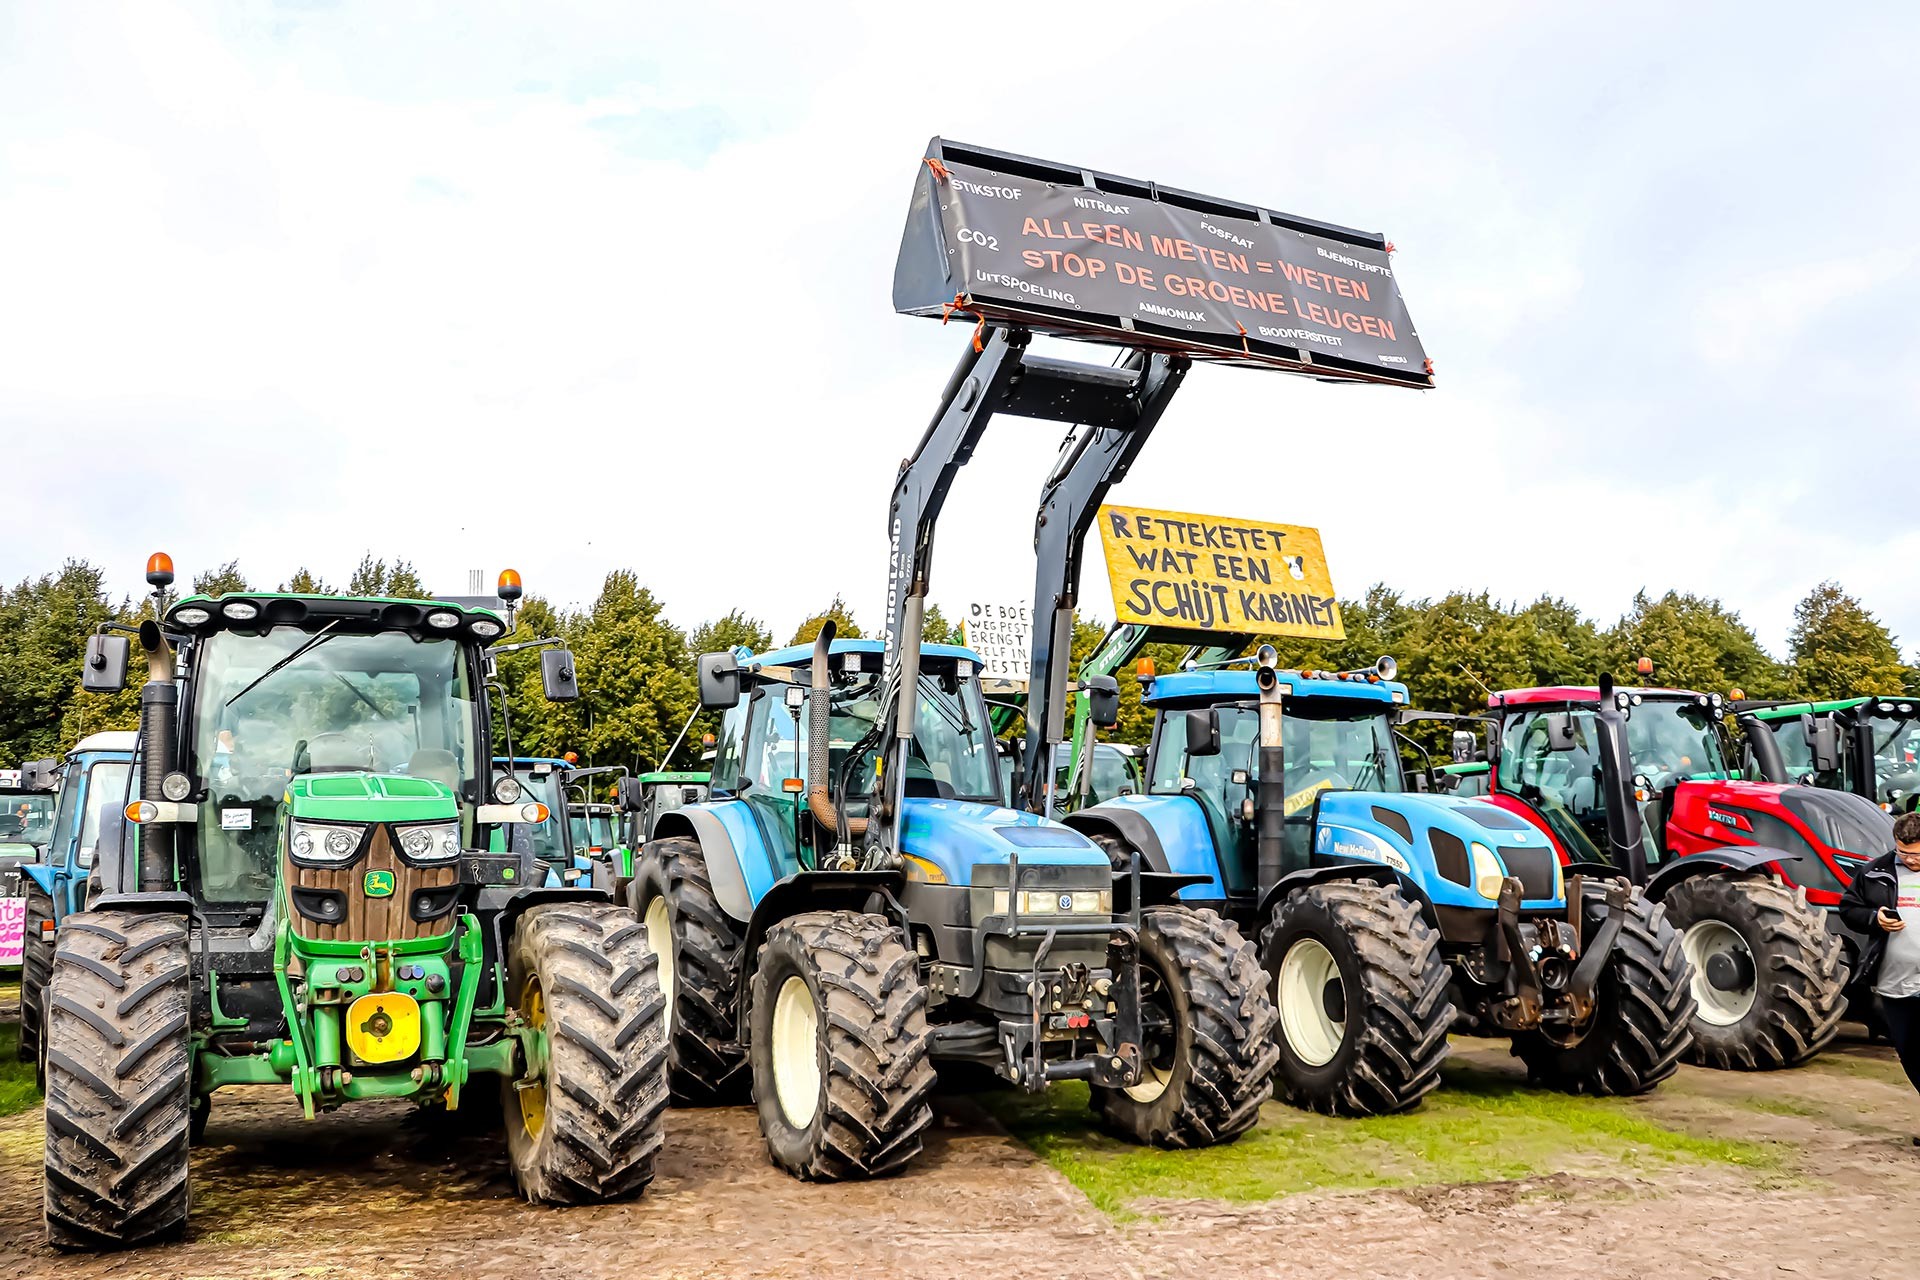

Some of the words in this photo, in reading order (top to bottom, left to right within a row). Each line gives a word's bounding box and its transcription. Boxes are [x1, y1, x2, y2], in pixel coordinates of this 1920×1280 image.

[951, 179, 1023, 201] STIKSTOF
[1073, 197, 1131, 215] NITRAAT
[956, 228, 1000, 252] CO2
[1200, 221, 1255, 249] FOSFAAT
[1022, 217, 1145, 251] ALLEEN
[1150, 235, 1250, 275] METEN
[1256, 261, 1275, 274] =
[1278, 259, 1371, 302] WETEN
[1316, 247, 1393, 278] BIJENSTERFTE
[976, 269, 1076, 304] UITSPOELING
[1022, 250, 1107, 279] STOP
[1115, 262, 1159, 291] DE
[1164, 273, 1289, 315] GROENE
[1292, 297, 1397, 341] LEUGEN
[1139, 301, 1207, 322] AMMONIAK
[1259, 326, 1343, 347] BIODIVERSITEIT
[1110, 513, 1287, 552] RETTEKETET
[886, 518, 901, 624] HOLLAND
[1126, 544, 1198, 575] WAT
[1213, 554, 1272, 585] EEN
[971, 603, 992, 618] DE
[971, 630, 1023, 646] BRENGT
[973, 645, 1005, 657] ZELF
[1012, 648, 1027, 659] IN
[882, 629, 895, 682] NEW
